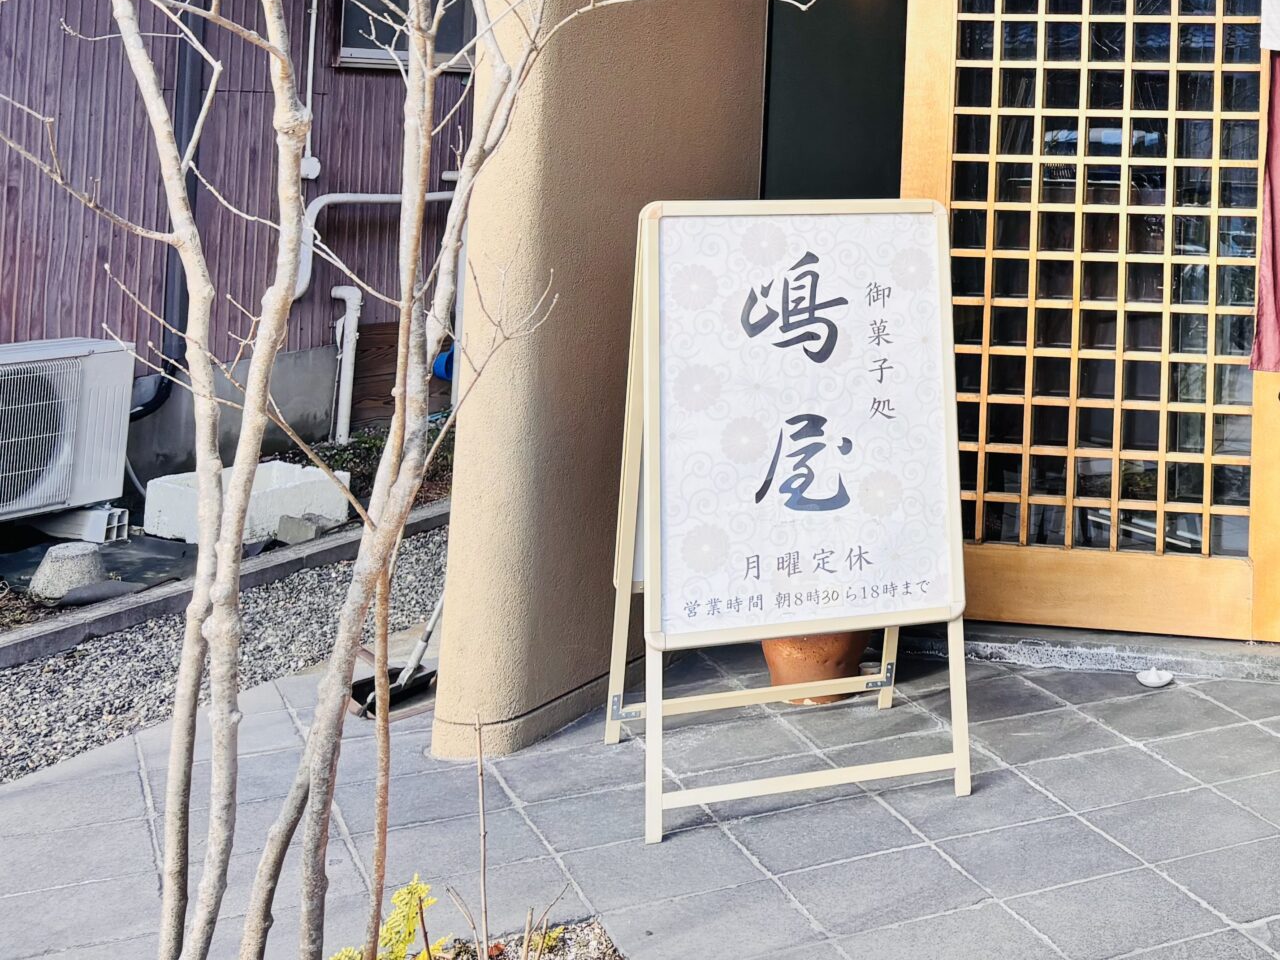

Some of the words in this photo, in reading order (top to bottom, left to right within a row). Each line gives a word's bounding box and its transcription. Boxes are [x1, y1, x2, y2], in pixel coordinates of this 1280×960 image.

[865, 281, 897, 420] 御菓子処
[743, 545, 874, 581] 月曜定休
[683, 594, 764, 618] 営業時間
